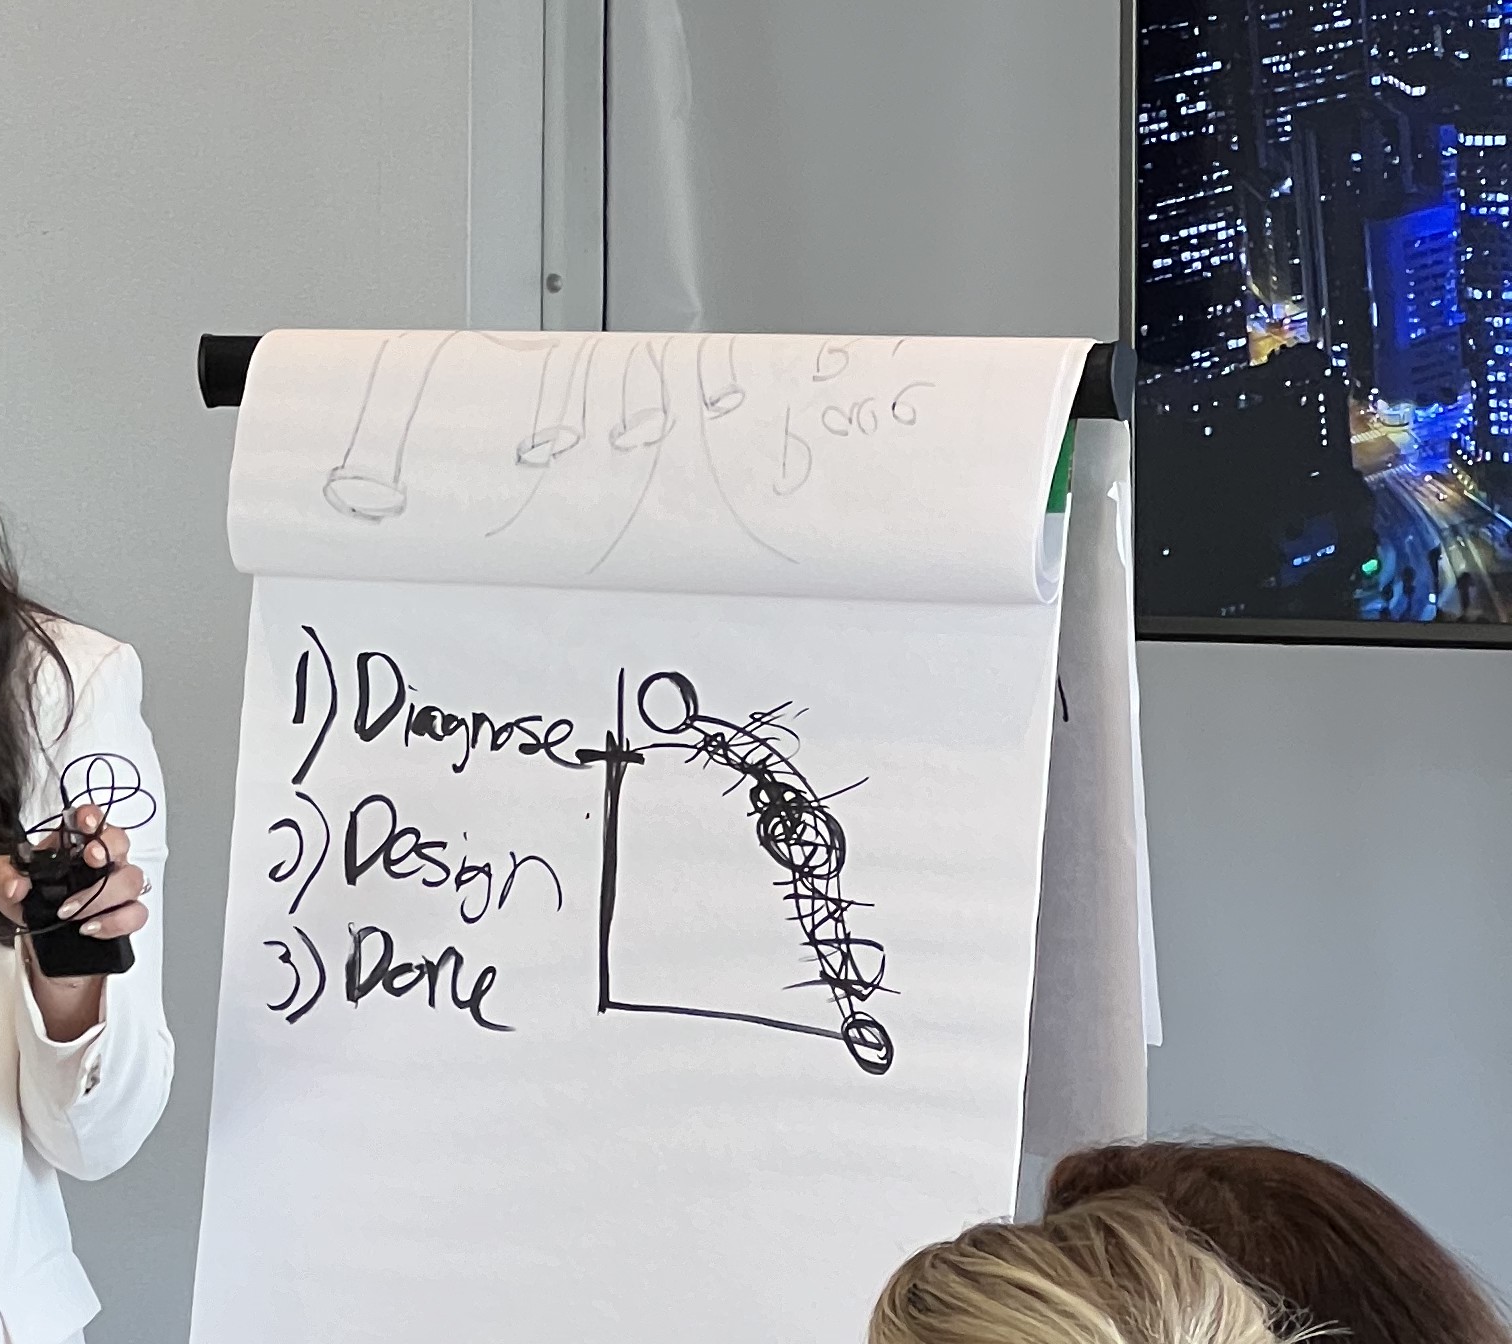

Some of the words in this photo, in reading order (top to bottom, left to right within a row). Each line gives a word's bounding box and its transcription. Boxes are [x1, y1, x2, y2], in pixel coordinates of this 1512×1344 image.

[354, 651, 590, 774] Diagnose
[344, 793, 563, 925] Design
[344, 922, 516, 1032] Done
